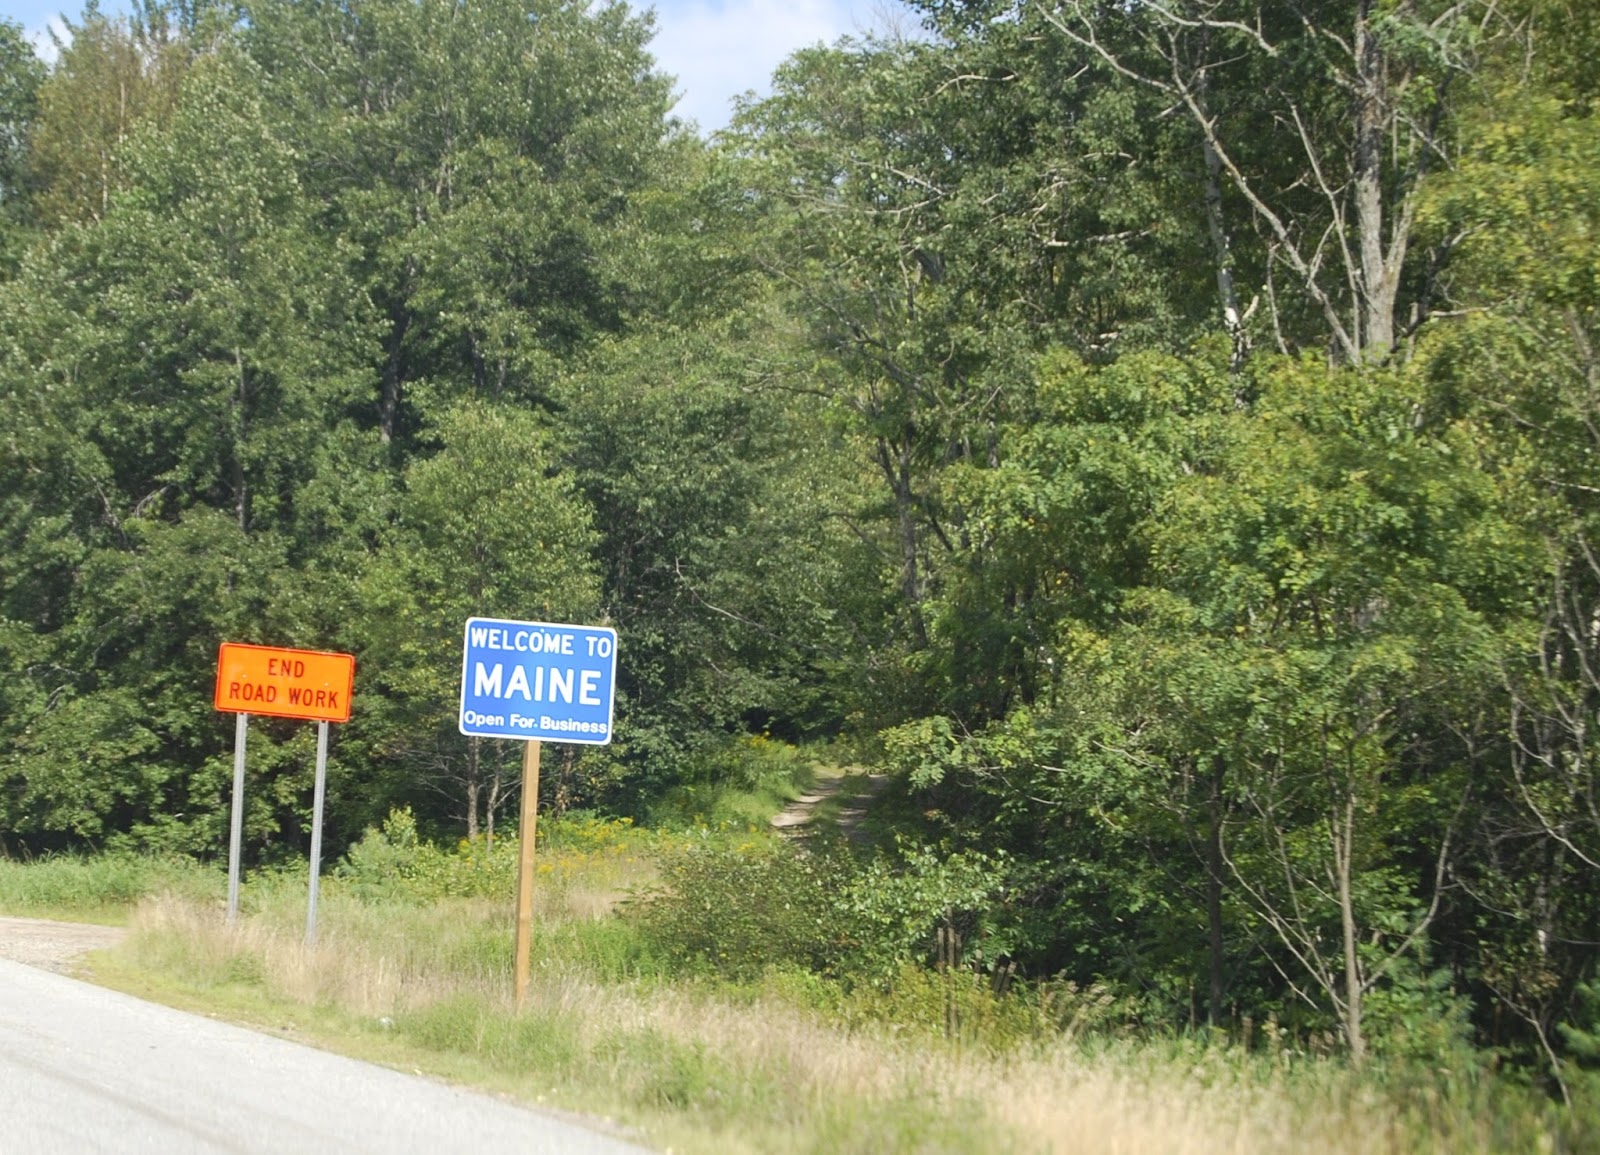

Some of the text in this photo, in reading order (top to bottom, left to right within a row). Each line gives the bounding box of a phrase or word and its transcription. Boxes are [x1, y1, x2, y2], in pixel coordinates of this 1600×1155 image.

[470, 627, 612, 658] WELCOME TO
[268, 658, 305, 678] END
[229, 682, 339, 709] ROAD WORK
[474, 662, 601, 706] MAINE
[464, 710, 608, 734] Open For Business
